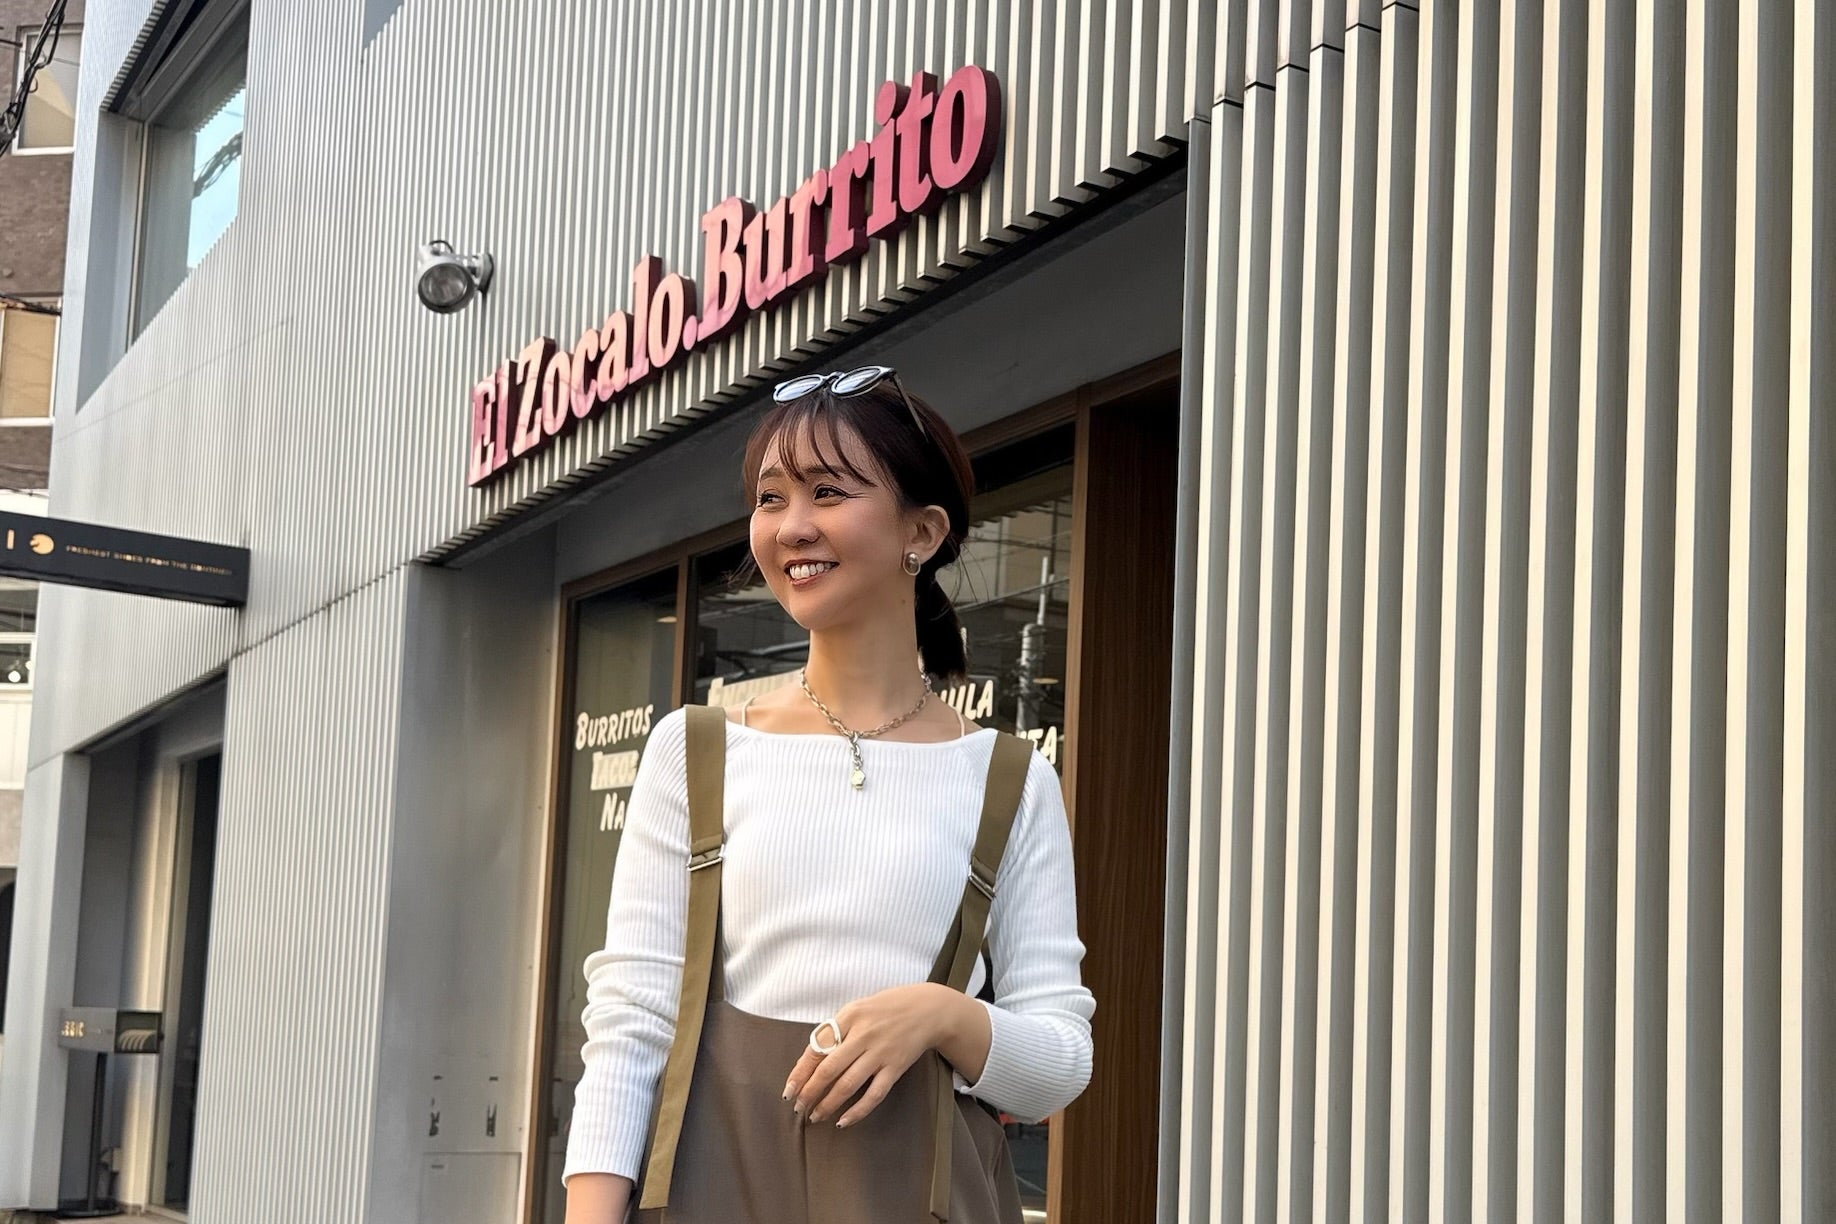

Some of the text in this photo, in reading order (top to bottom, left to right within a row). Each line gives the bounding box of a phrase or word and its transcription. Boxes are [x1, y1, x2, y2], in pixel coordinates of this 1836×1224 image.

[468, 358, 513, 487] El
[697, 64, 996, 341] Burrito
[575, 704, 654, 750] BURRITOS
[590, 750, 639, 790] TACOS
[600, 792, 626, 831] NA
